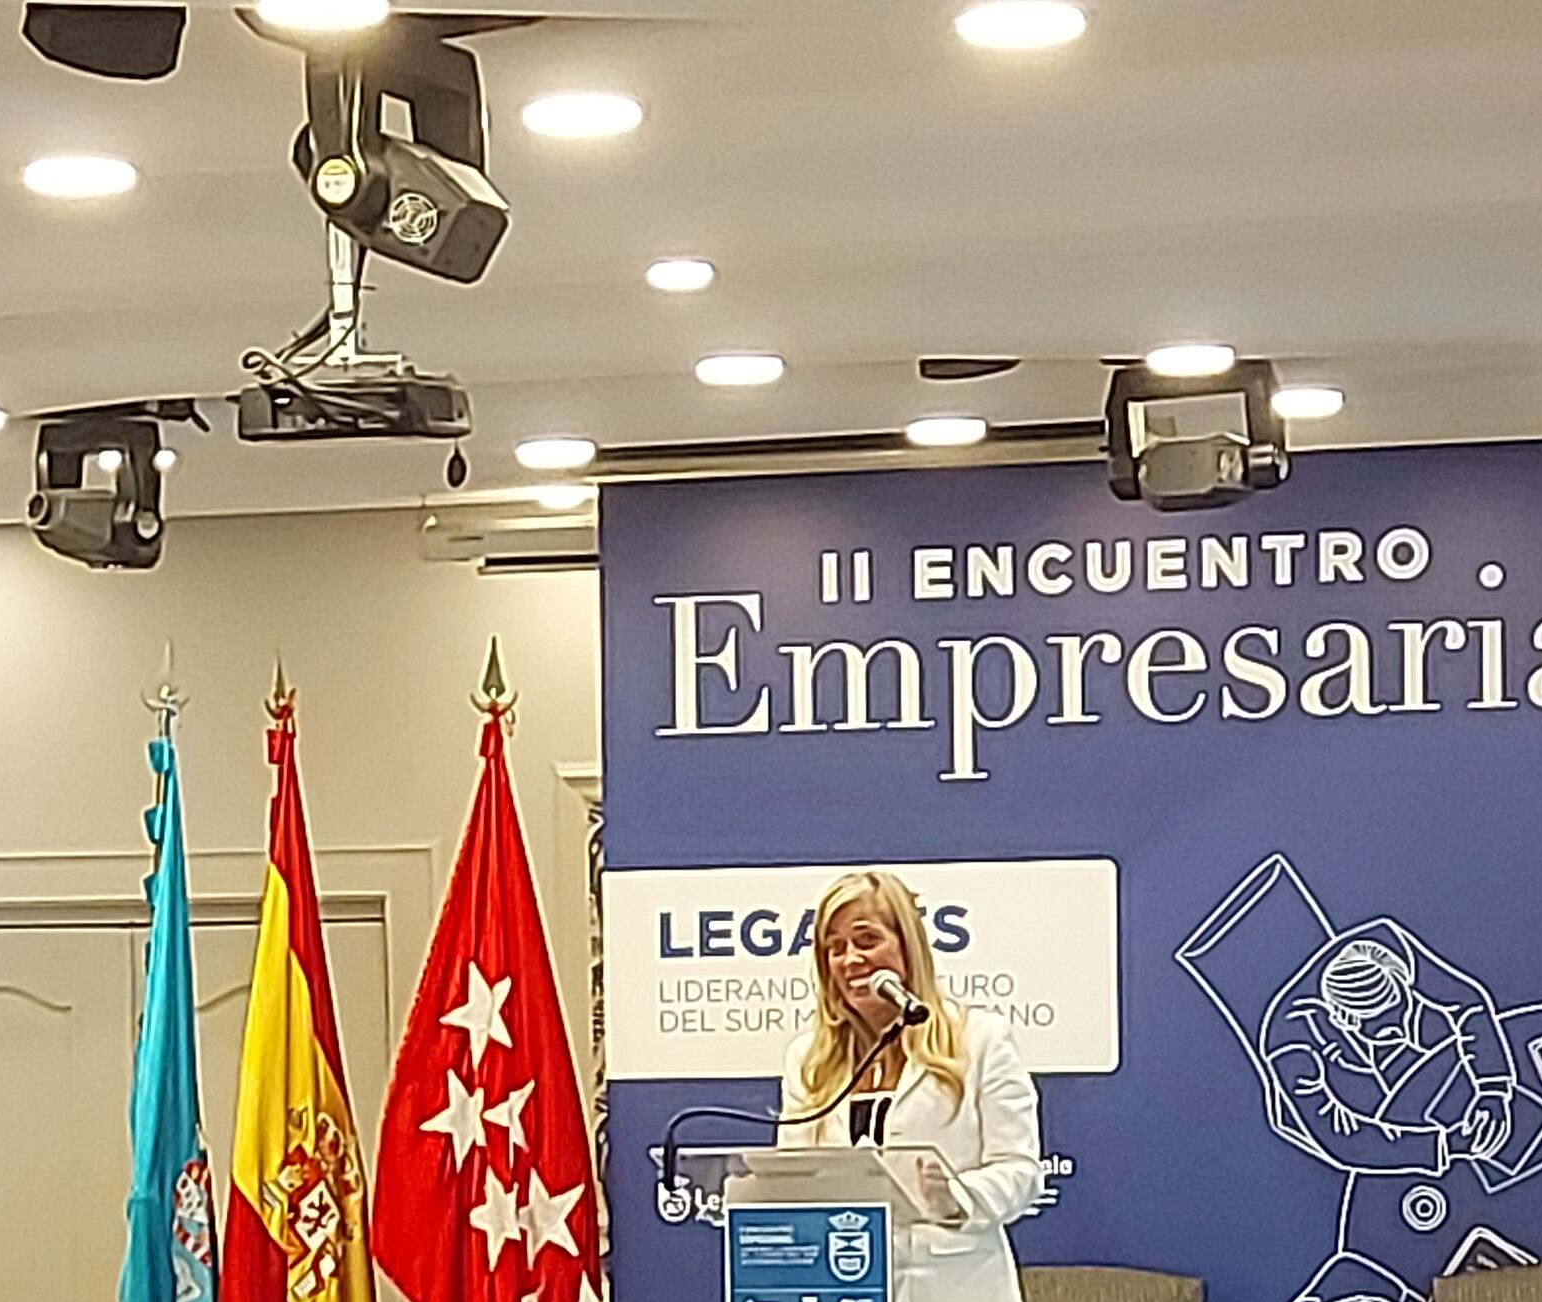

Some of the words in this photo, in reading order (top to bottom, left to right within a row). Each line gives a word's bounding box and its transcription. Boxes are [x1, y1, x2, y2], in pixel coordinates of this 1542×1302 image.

[821, 550, 871, 603] II
[913, 527, 1430, 600] ENCUENTRO
[659, 977, 817, 1003] LIDERAND
[659, 1009, 716, 1033] DEL
[725, 1008, 784, 1032] SUR
